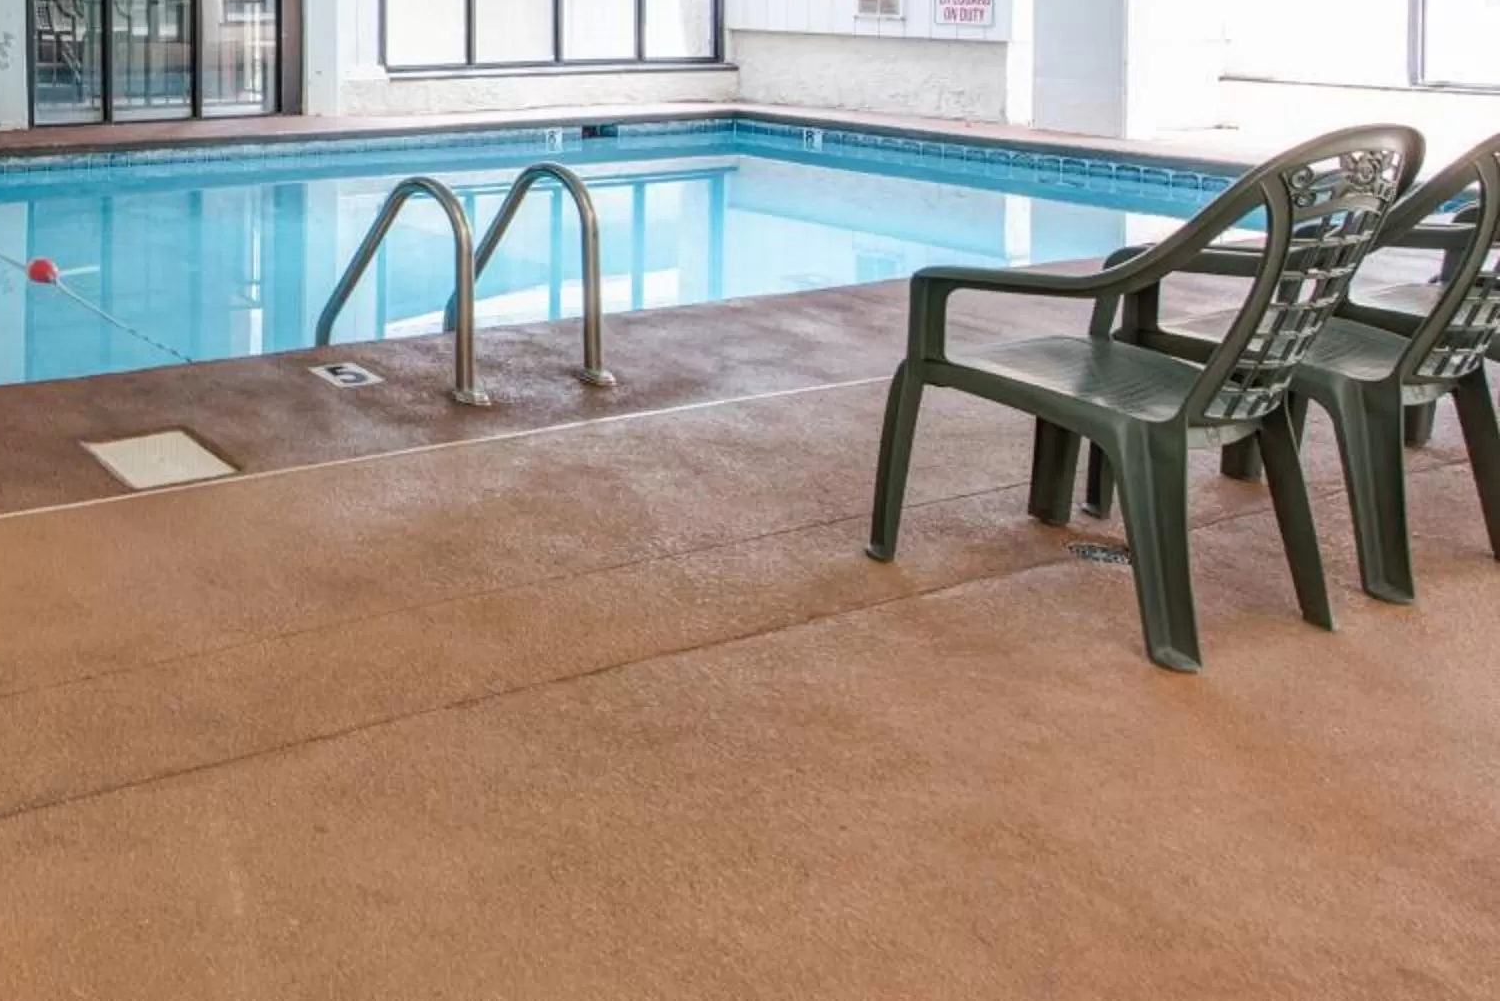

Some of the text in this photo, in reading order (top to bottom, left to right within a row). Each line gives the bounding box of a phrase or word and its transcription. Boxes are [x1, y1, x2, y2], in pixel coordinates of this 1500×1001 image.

[943, 6, 985, 21] ON DUTY
[323, 365, 369, 384] 5
